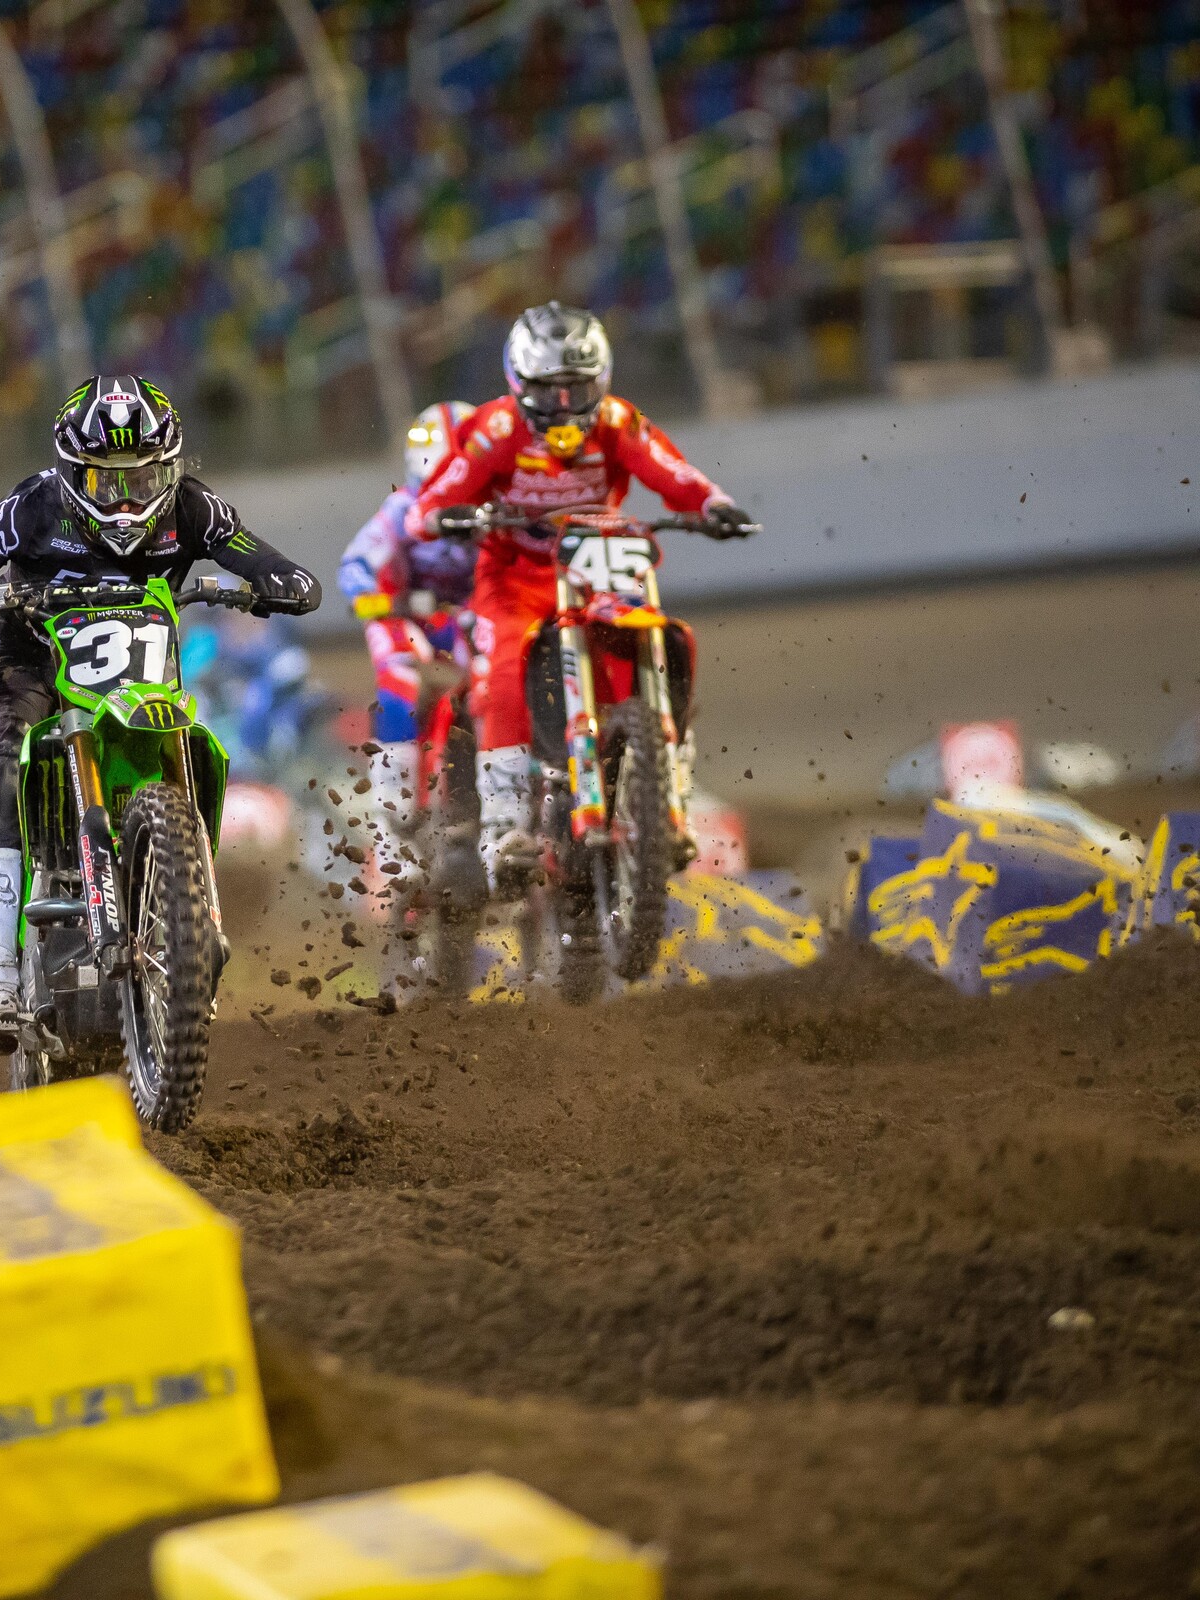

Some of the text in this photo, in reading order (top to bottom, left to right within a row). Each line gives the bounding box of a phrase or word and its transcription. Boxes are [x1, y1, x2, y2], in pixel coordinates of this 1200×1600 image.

[105, 394, 132, 402] BELL
[52, 537, 72, 546] PRO
[145, 542, 181, 557] Kawas
[568, 537, 651, 592] 45
[96, 609, 145, 618] MONSTER
[69, 620, 170, 686] 31
[72, 774, 85, 823] CIRCUI
[81, 835, 94, 883] BRAKING
[98, 846, 120, 933] NLOP
